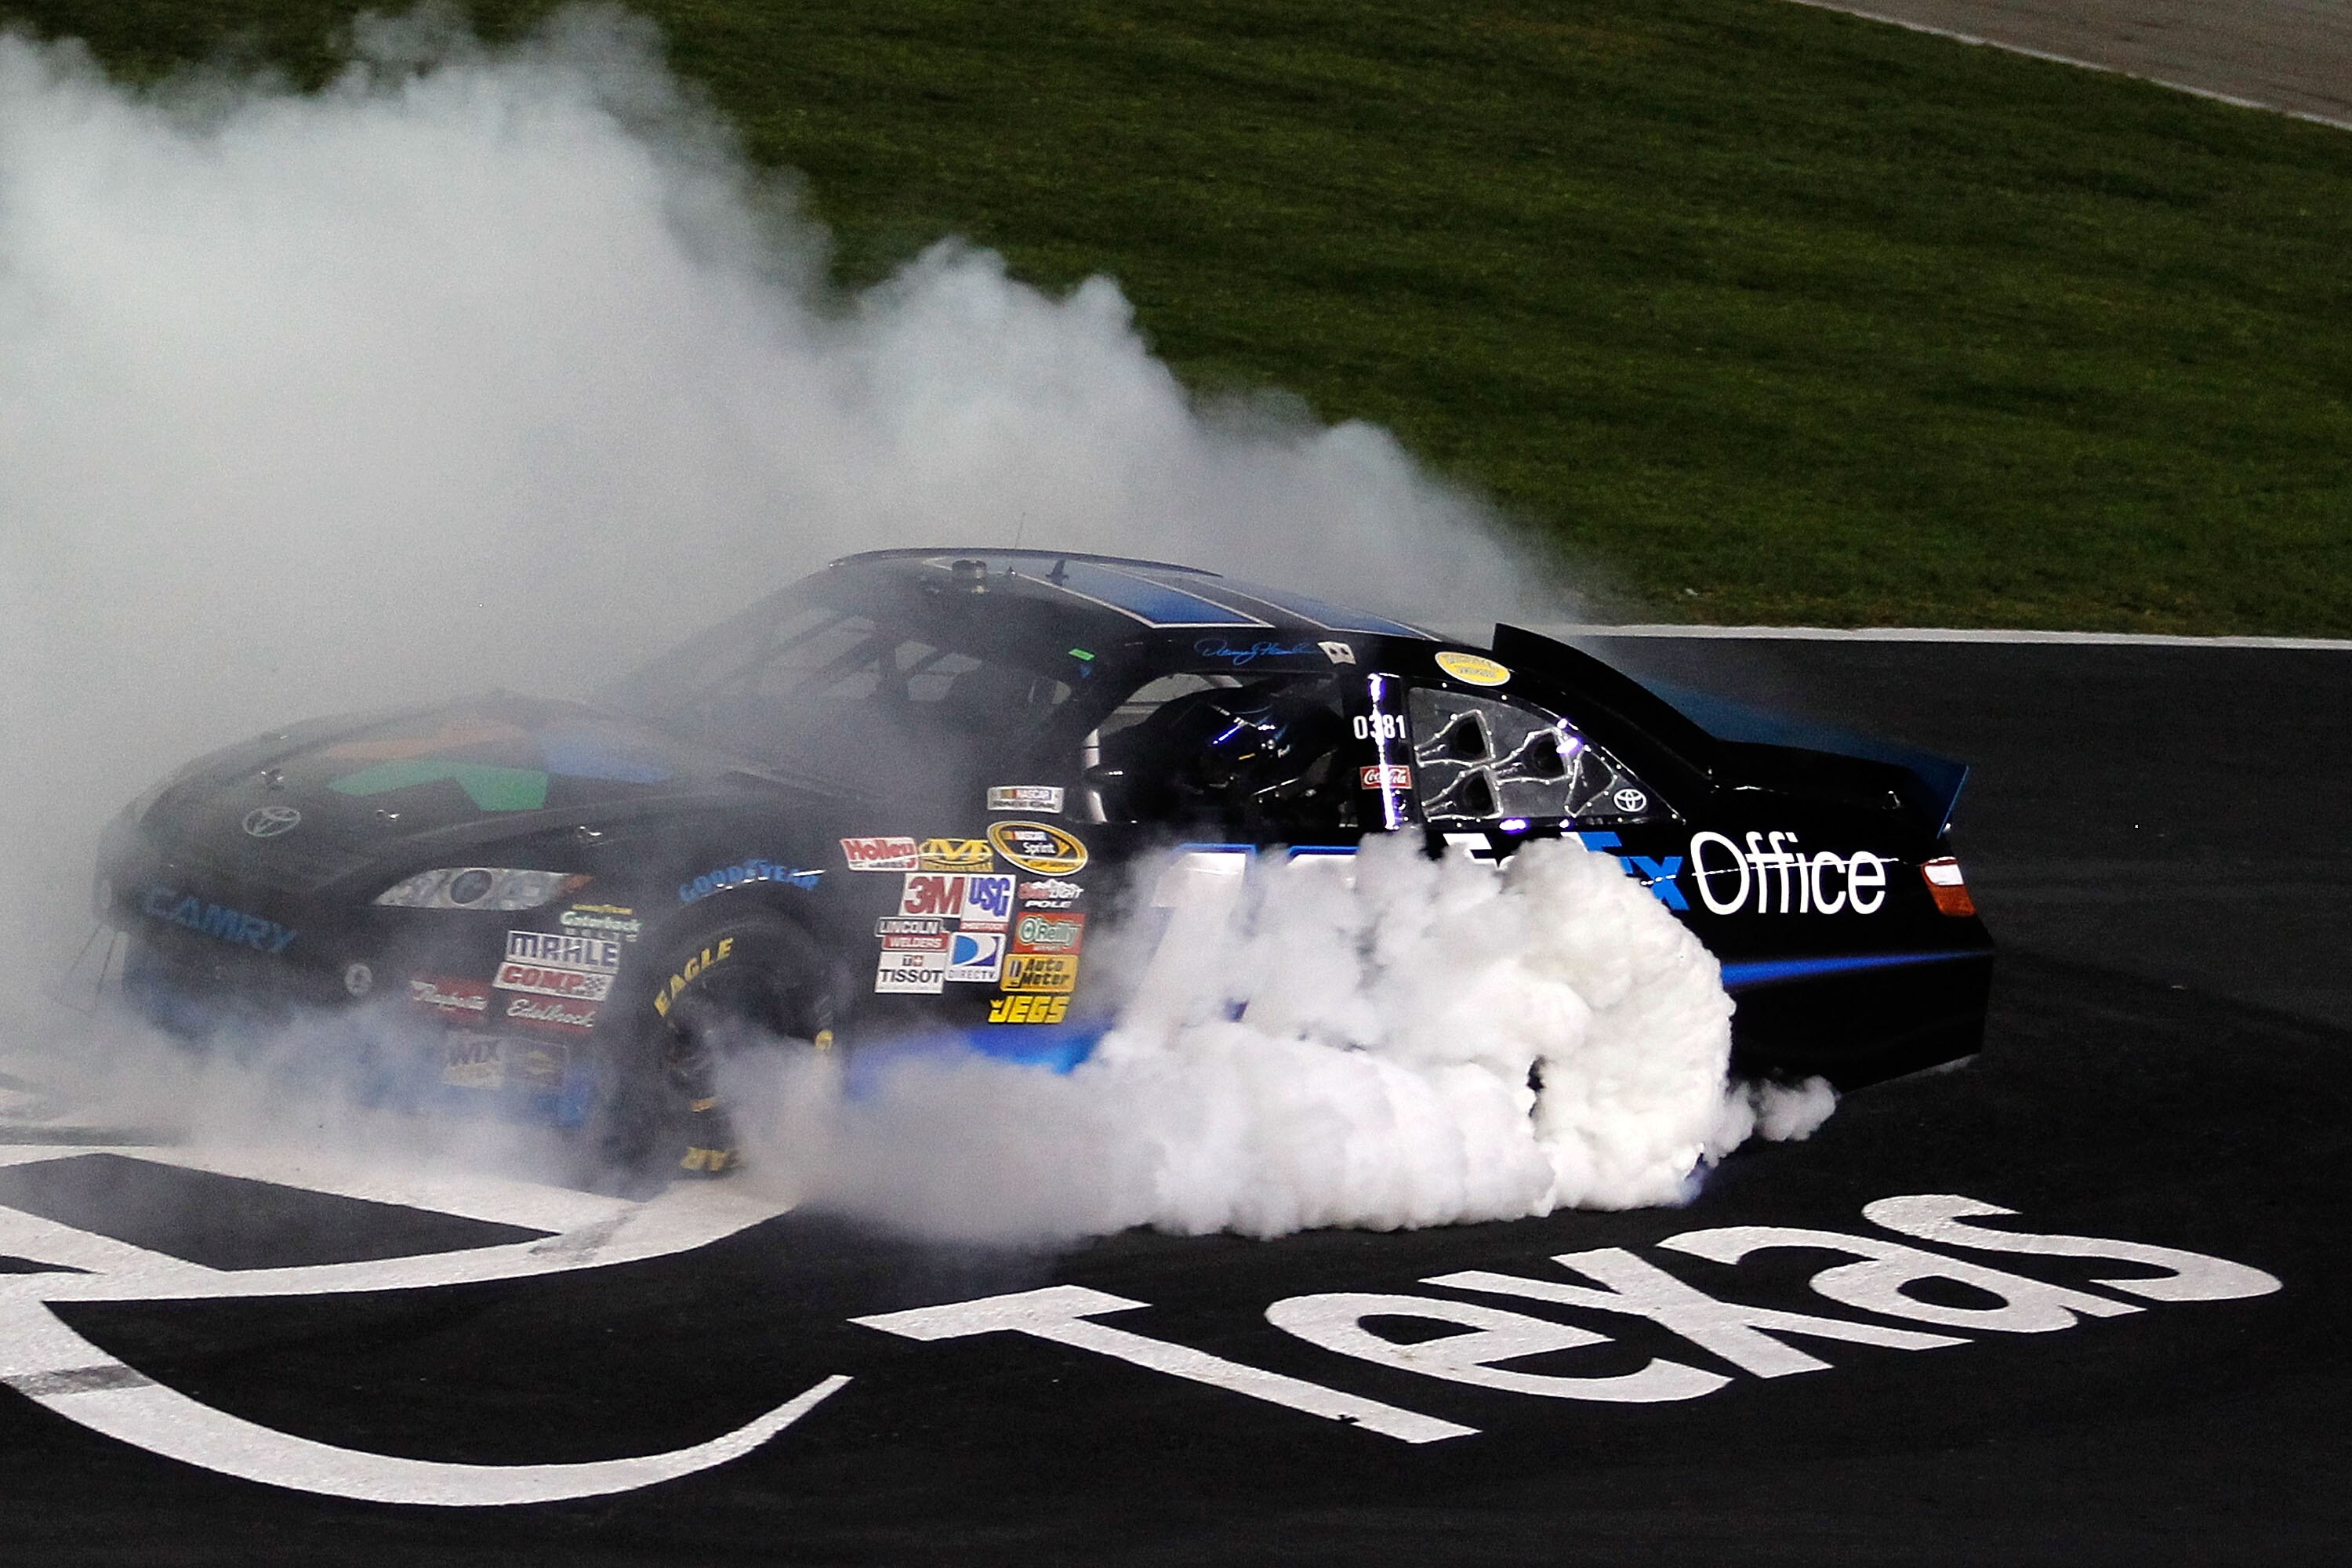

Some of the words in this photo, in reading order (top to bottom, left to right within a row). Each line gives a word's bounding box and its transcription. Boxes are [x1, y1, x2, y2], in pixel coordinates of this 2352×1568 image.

[1353, 714, 1406, 739] 0381
[844, 839, 916, 869] Holley
[1022, 842, 1057, 855] Sprint
[1690, 831, 1886, 915] Office
[905, 877, 966, 914] 3M
[969, 877, 1011, 916] USG
[879, 920, 938, 934] LINCOLN
[510, 933, 618, 967] MAHLE
[887, 936, 942, 948] WELDERS
[654, 938, 734, 1017] EAGLE
[880, 969, 943, 983] TISSOT
[948, 969, 996, 979] DIRECTV
[1022, 971, 1069, 985] Meter
[1025, 959, 1065, 972] Auto
[503, 966, 585, 993] COMP
[988, 996, 1071, 1023] JEGS
[847, 1194, 2285, 1444] Texas
